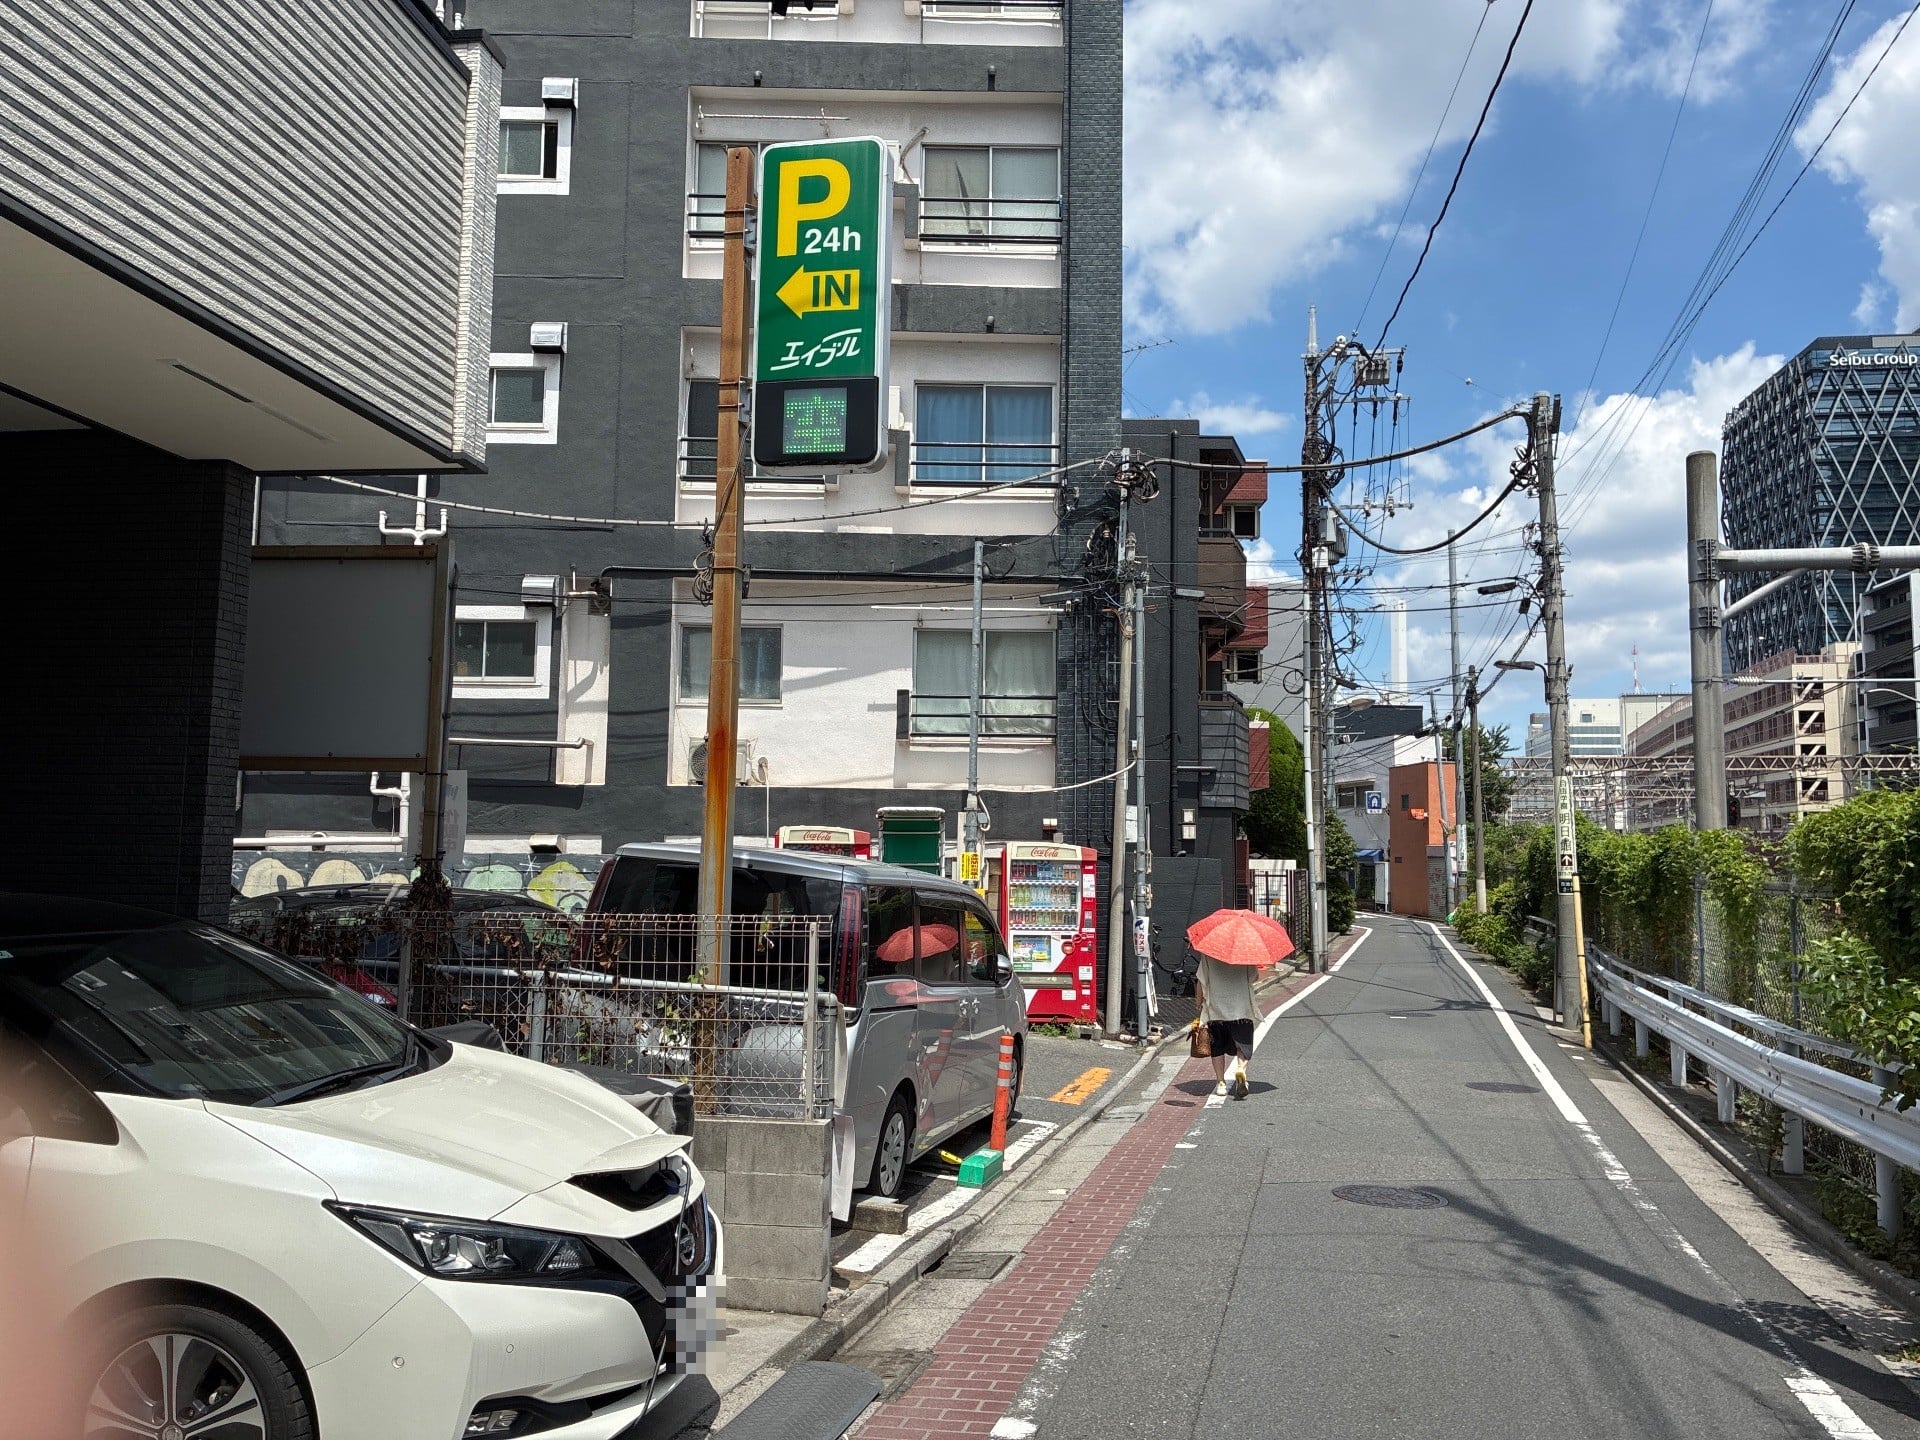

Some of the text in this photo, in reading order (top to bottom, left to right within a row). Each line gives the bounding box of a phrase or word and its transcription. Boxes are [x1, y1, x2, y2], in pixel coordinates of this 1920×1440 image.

[777, 158, 851, 257] P
[804, 226, 861, 254] 24h
[812, 273, 852, 307] IN
[770, 328, 862, 371] エイブル
[1829, 352, 1918, 366] Seibu Group
[785, 396, 845, 453] 空
